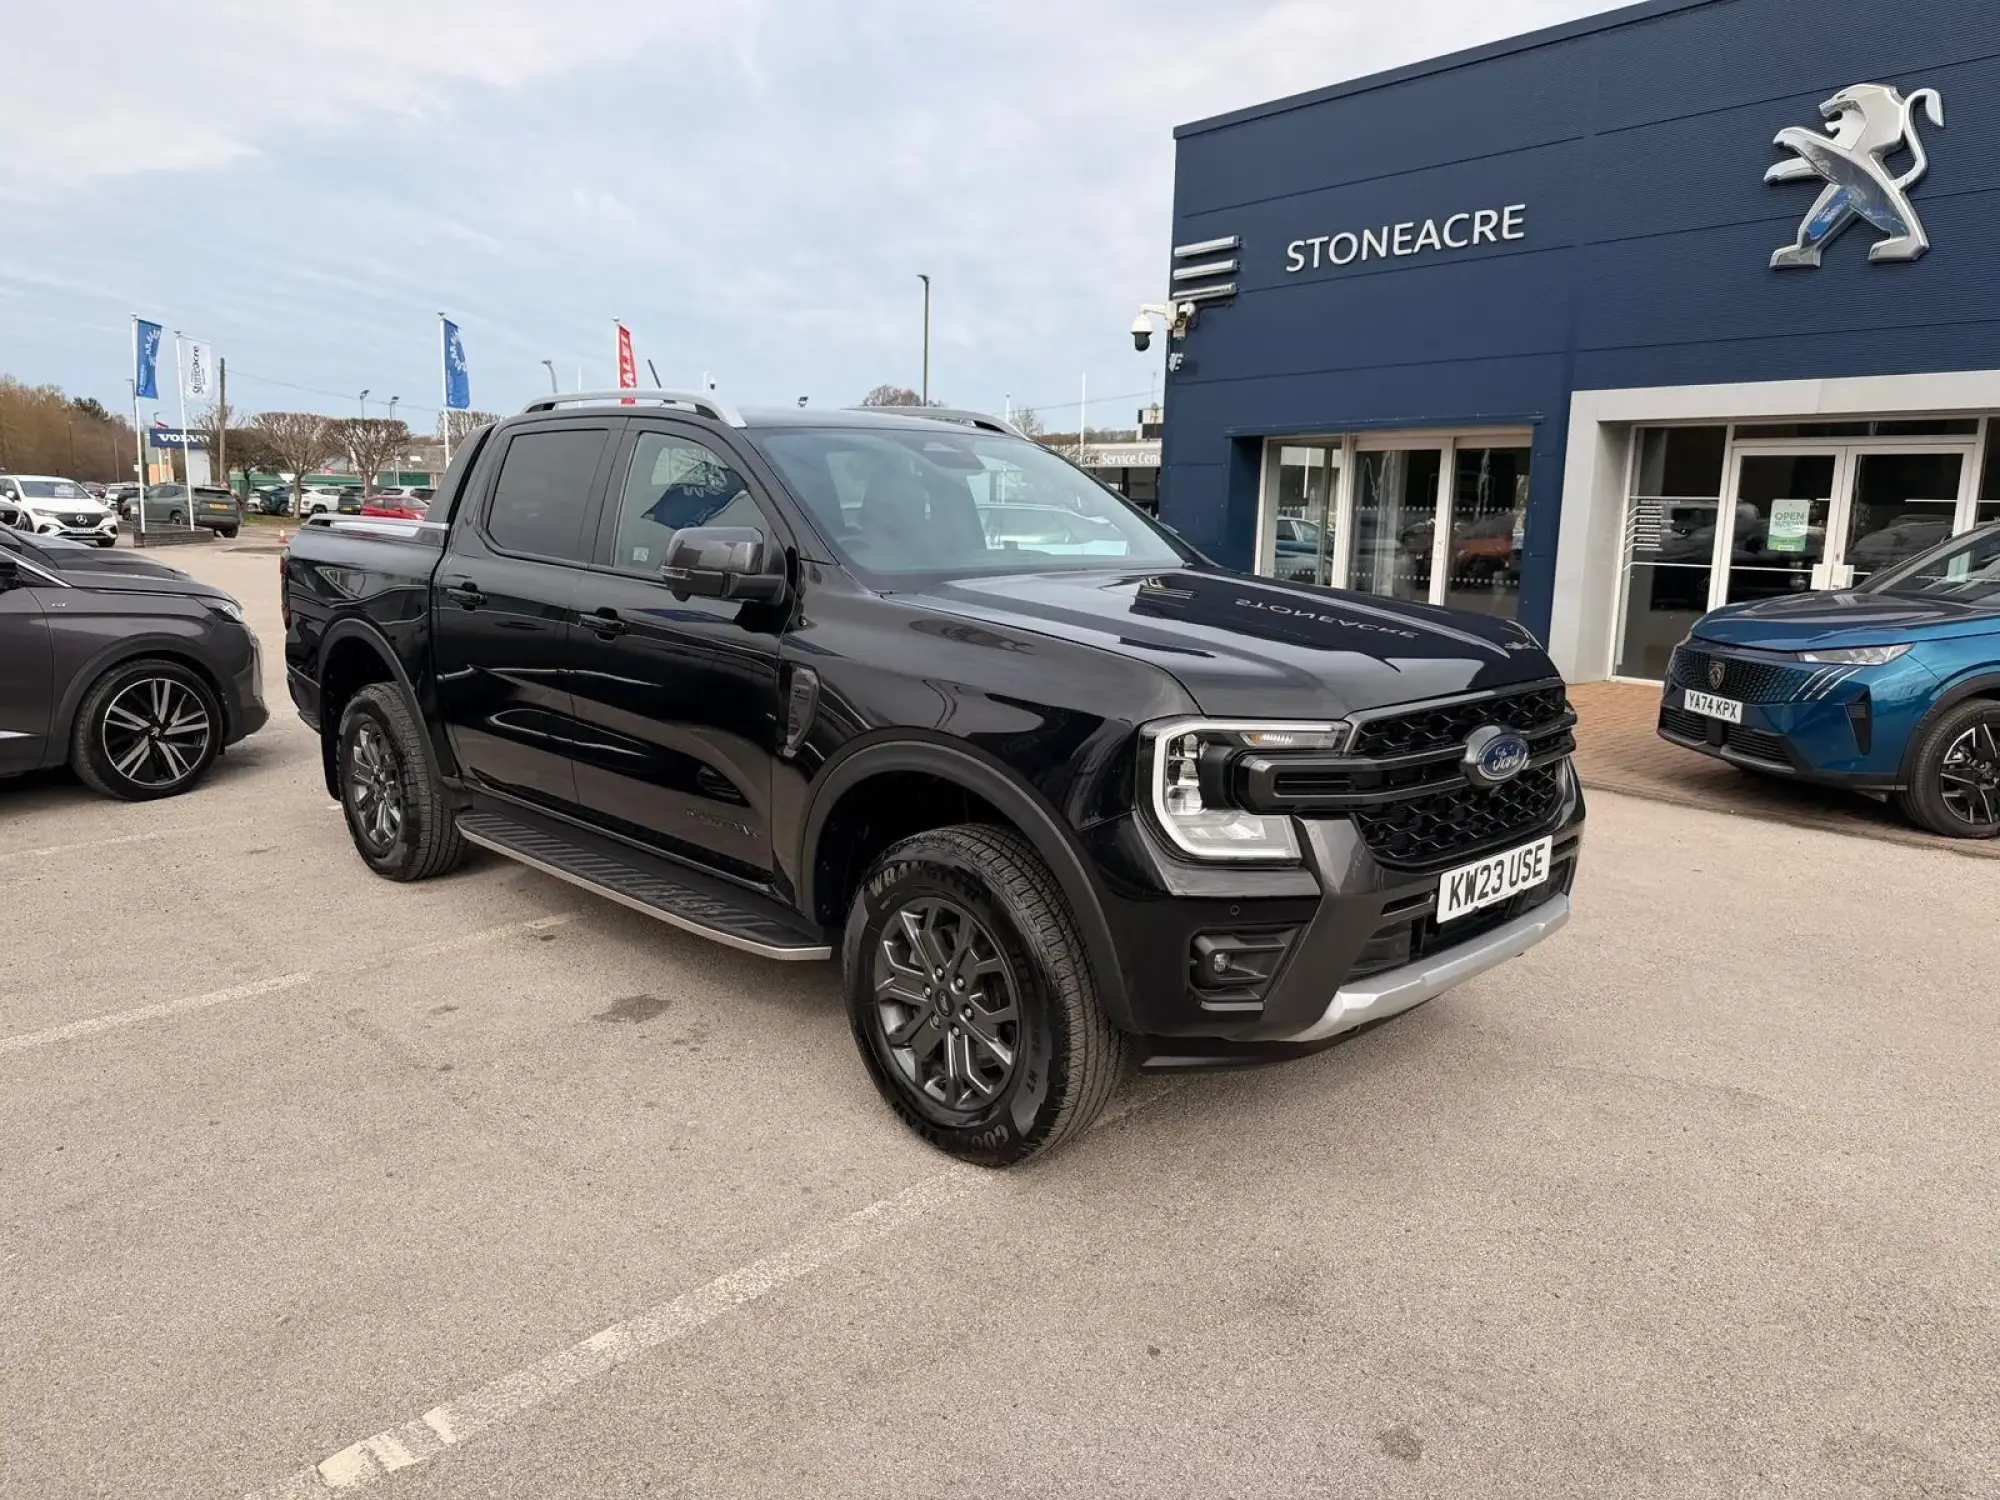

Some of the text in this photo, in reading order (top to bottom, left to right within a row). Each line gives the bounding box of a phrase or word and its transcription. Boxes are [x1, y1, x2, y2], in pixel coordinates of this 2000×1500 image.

[1286, 199, 1526, 272] STONEACRE
[1102, 452, 1136, 465] Service
[1774, 511, 1805, 521] OPEN
[1689, 692, 1738, 719] YA74 KPX
[1492, 745, 1520, 771] Ford
[1448, 843, 1546, 912] KW23 USE
